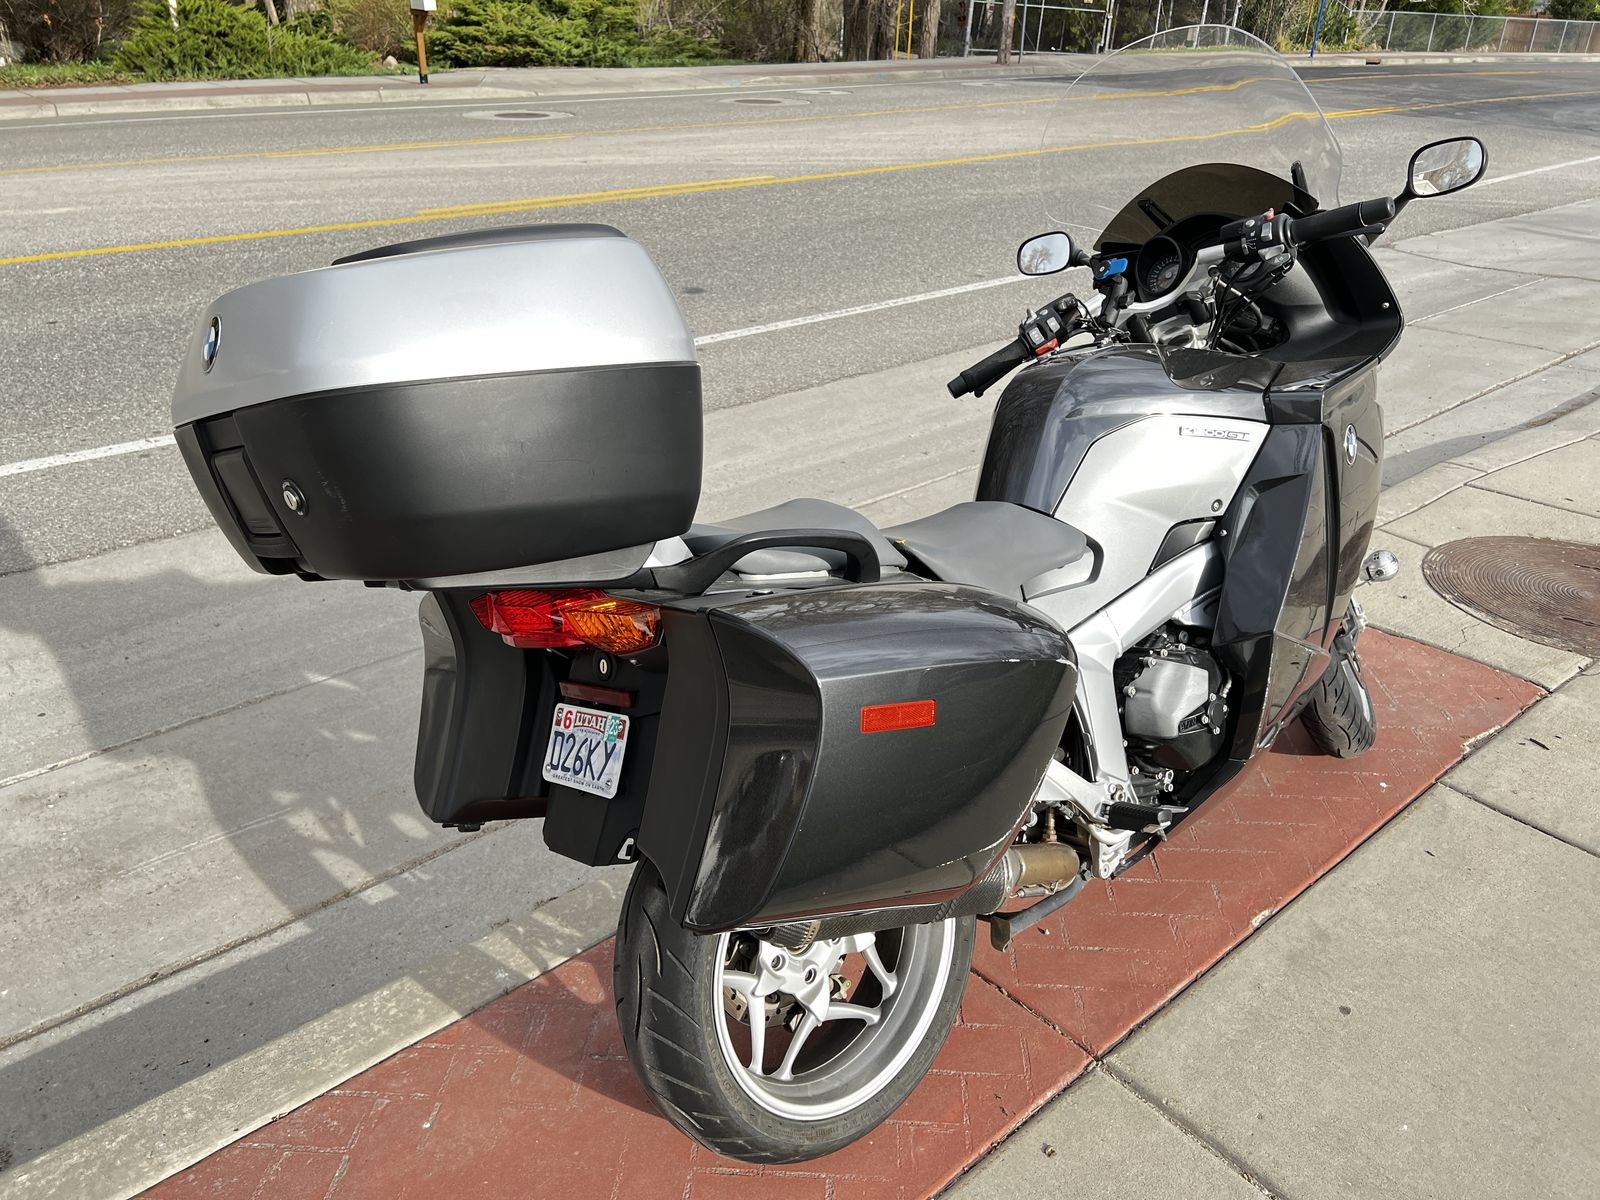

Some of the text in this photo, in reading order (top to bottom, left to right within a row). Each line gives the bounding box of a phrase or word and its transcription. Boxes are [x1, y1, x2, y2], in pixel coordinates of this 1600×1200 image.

[1180, 426, 1250, 441] K100GT
[563, 710, 573, 730] 6
[575, 713, 607, 732] UTAH
[550, 731, 616, 781] D26KY
